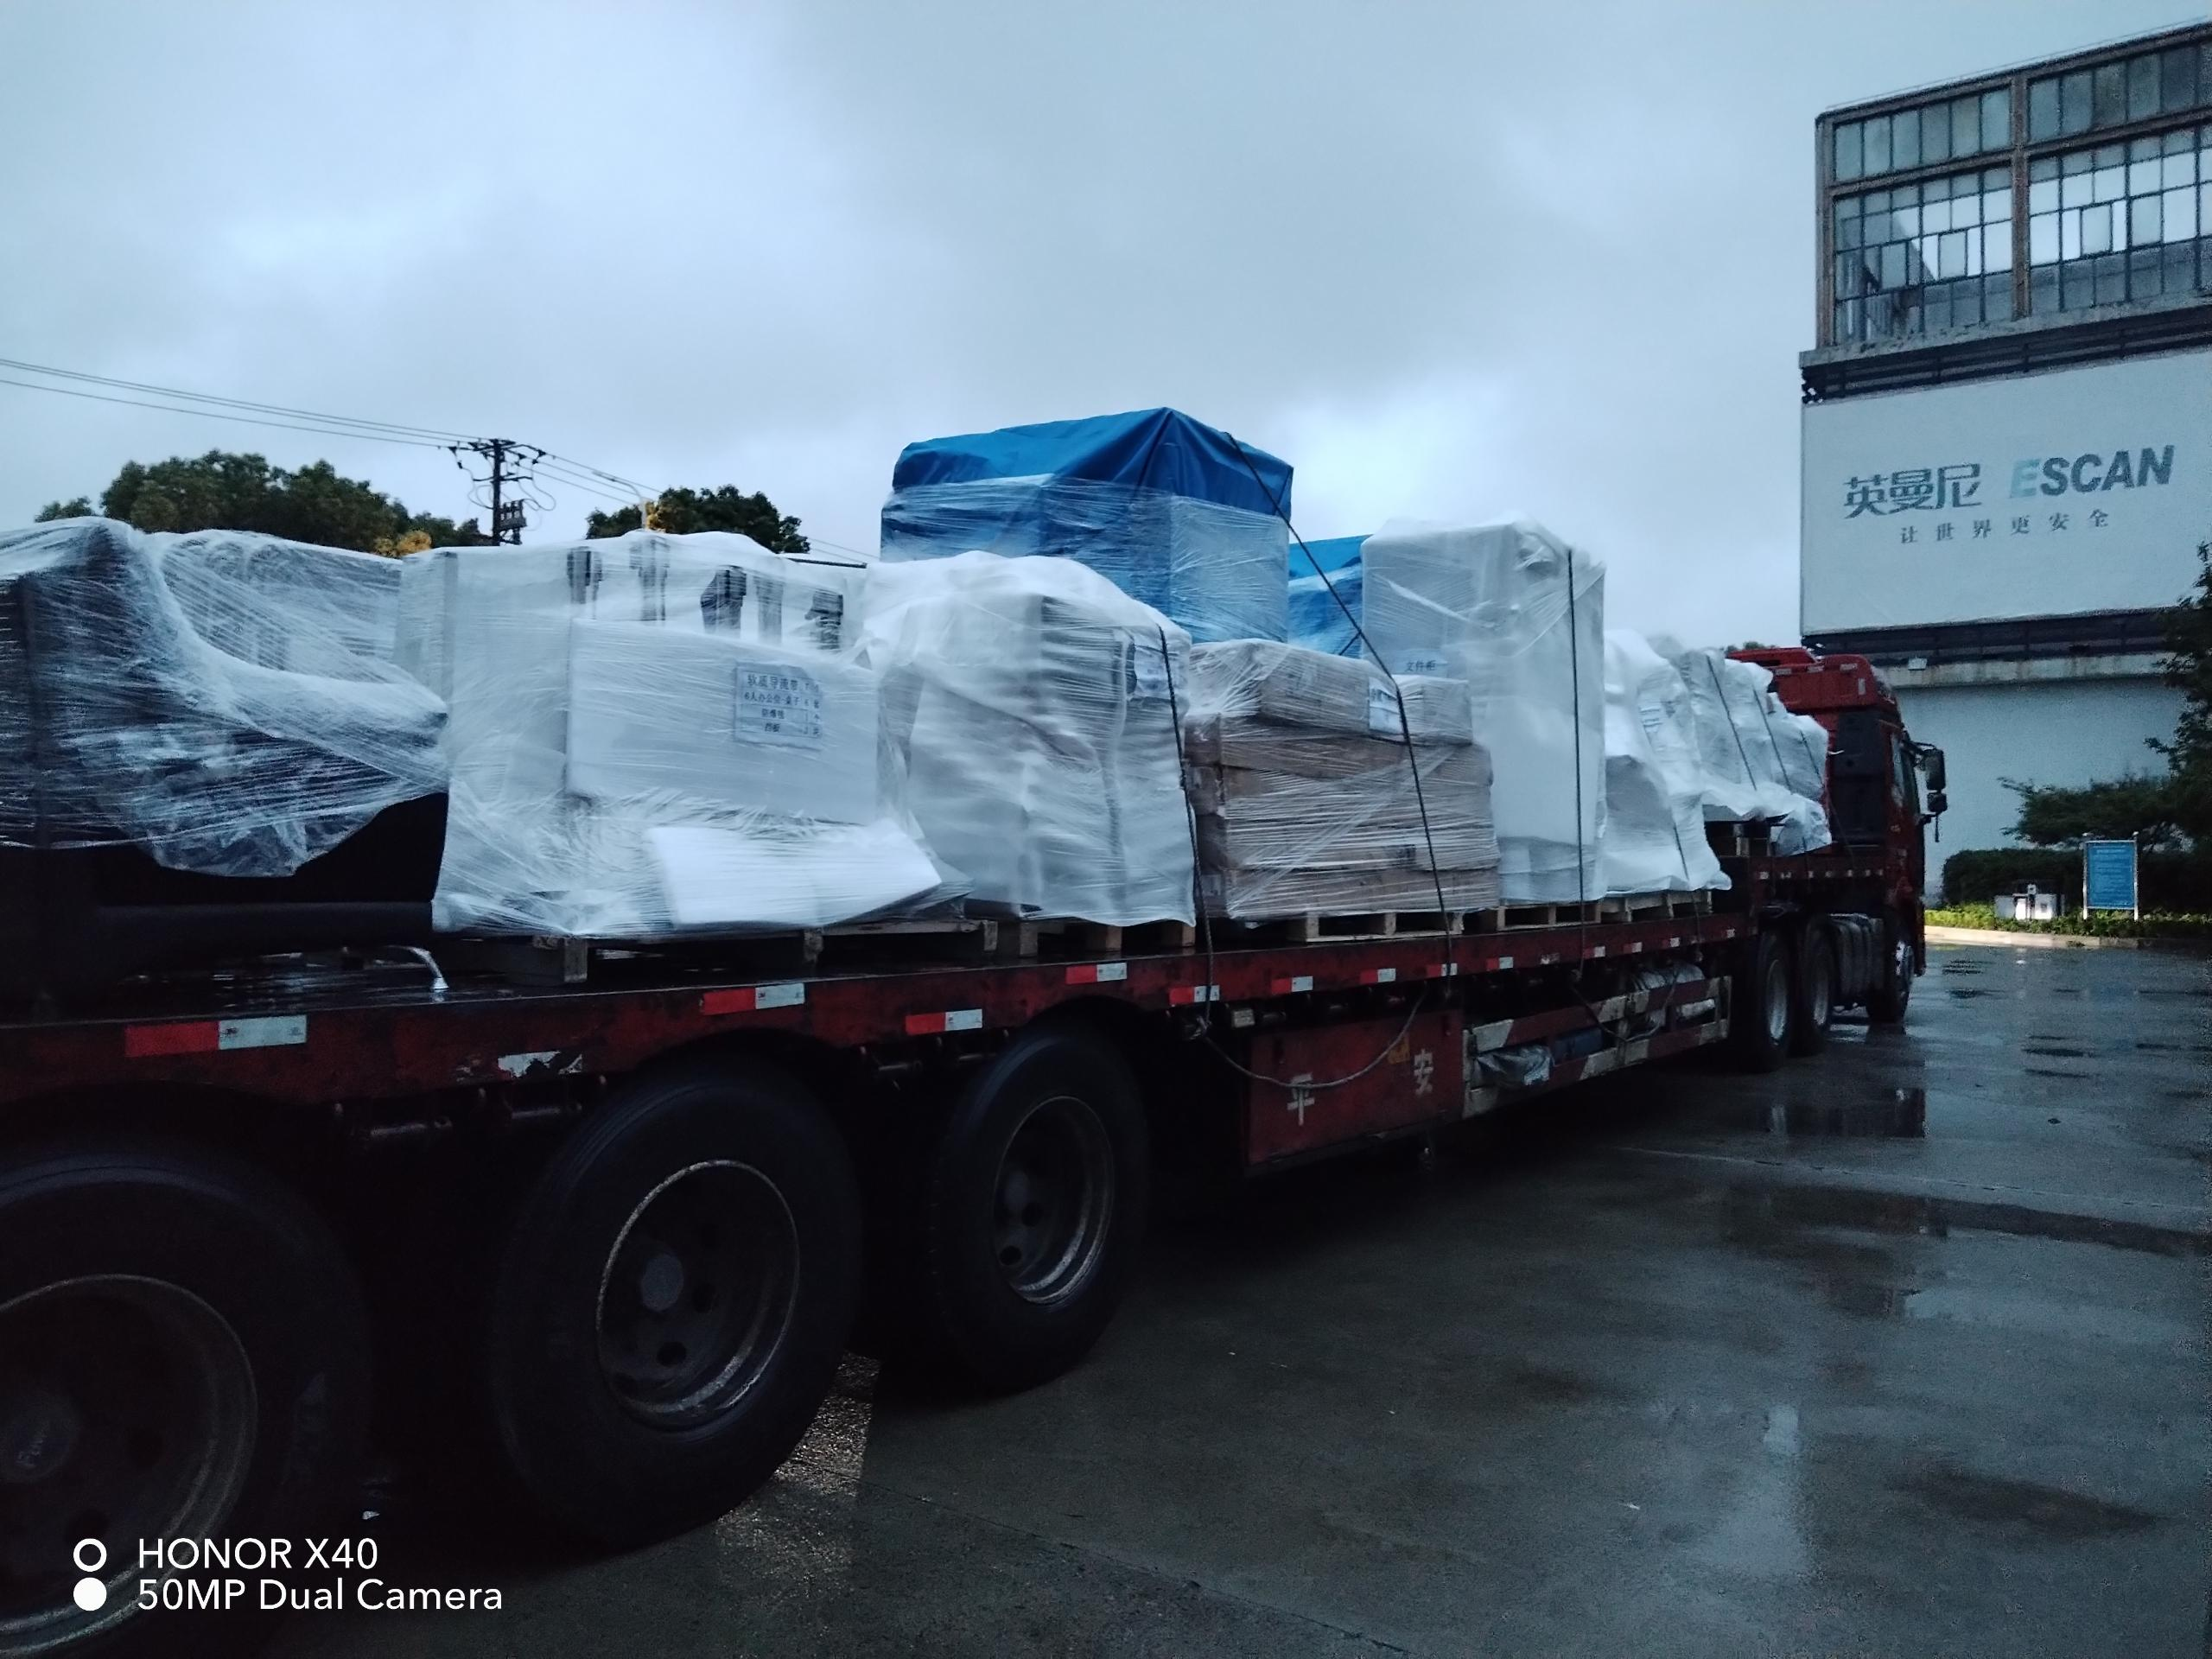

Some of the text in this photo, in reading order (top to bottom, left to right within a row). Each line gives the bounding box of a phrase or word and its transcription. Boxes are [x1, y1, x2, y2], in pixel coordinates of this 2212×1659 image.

[1842, 462, 1982, 519] 英曼尼
[2008, 444, 2176, 499] ESCAN
[1900, 508, 2109, 544] 让世界更安全
[1404, 659, 1438, 672] 文件柜
